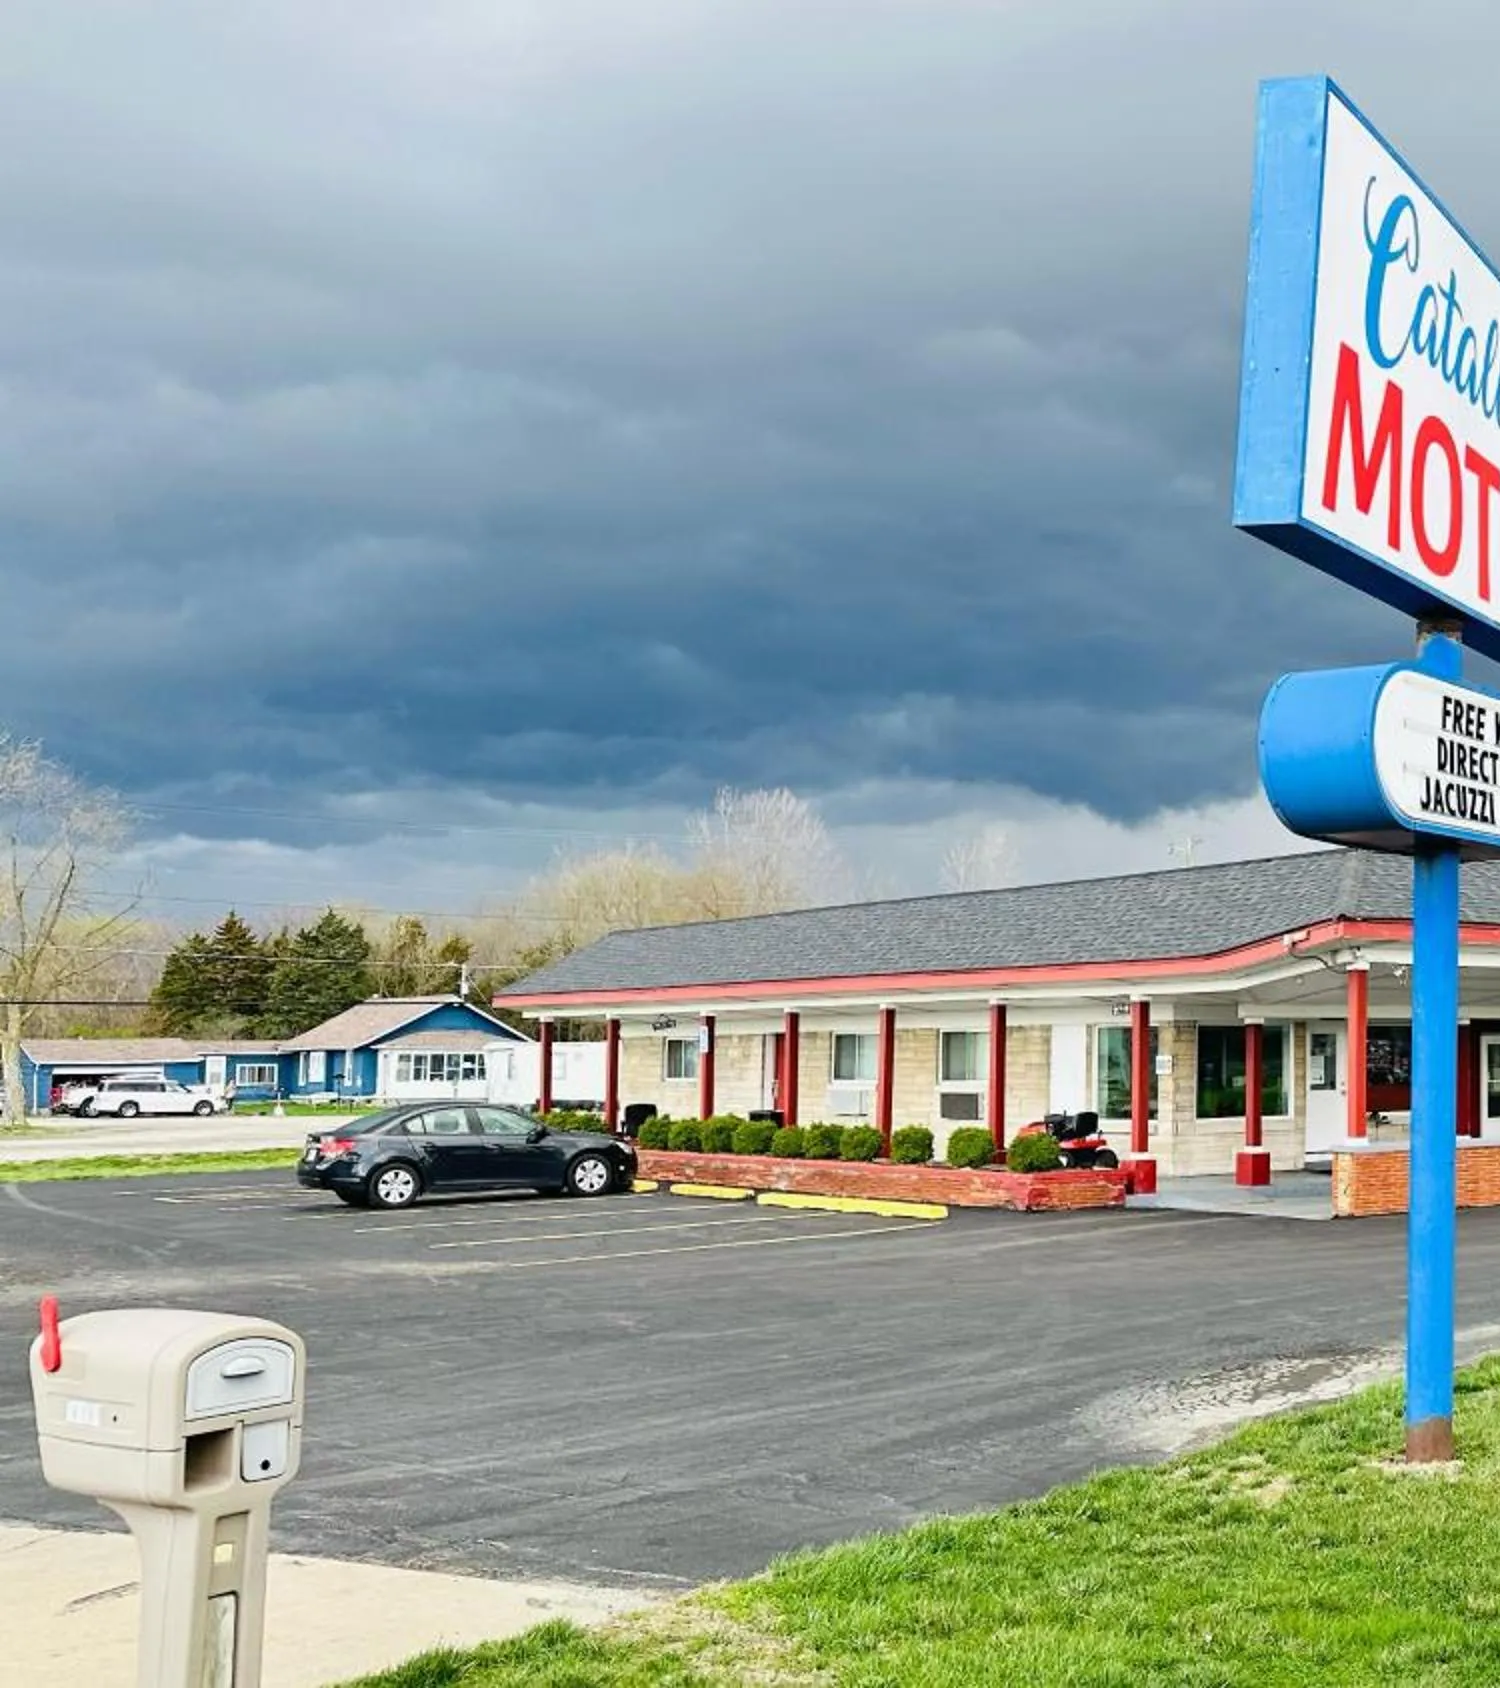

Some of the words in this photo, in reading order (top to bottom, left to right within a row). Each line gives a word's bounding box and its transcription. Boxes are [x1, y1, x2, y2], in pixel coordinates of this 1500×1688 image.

[1442, 696, 1486, 741] FREE
[1437, 737, 1499, 787] DIRECT
[1421, 776, 1496, 825] JACUZZI
